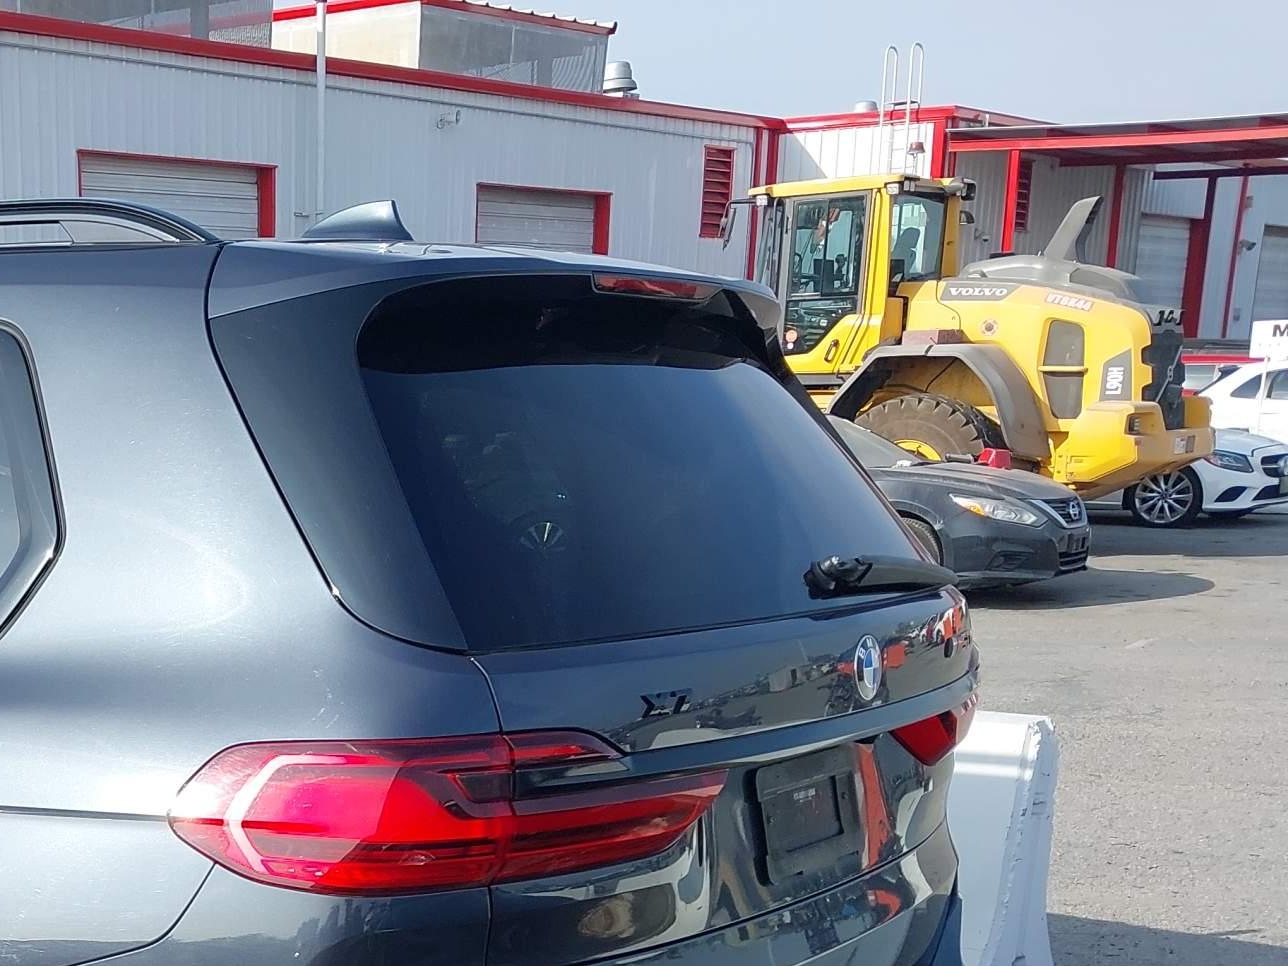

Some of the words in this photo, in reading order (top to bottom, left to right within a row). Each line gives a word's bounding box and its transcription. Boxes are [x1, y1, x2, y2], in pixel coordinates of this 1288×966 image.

[949, 287, 1008, 296] VOLVO
[1105, 366, 1125, 395] L90H
[640, 688, 692, 719] X7
